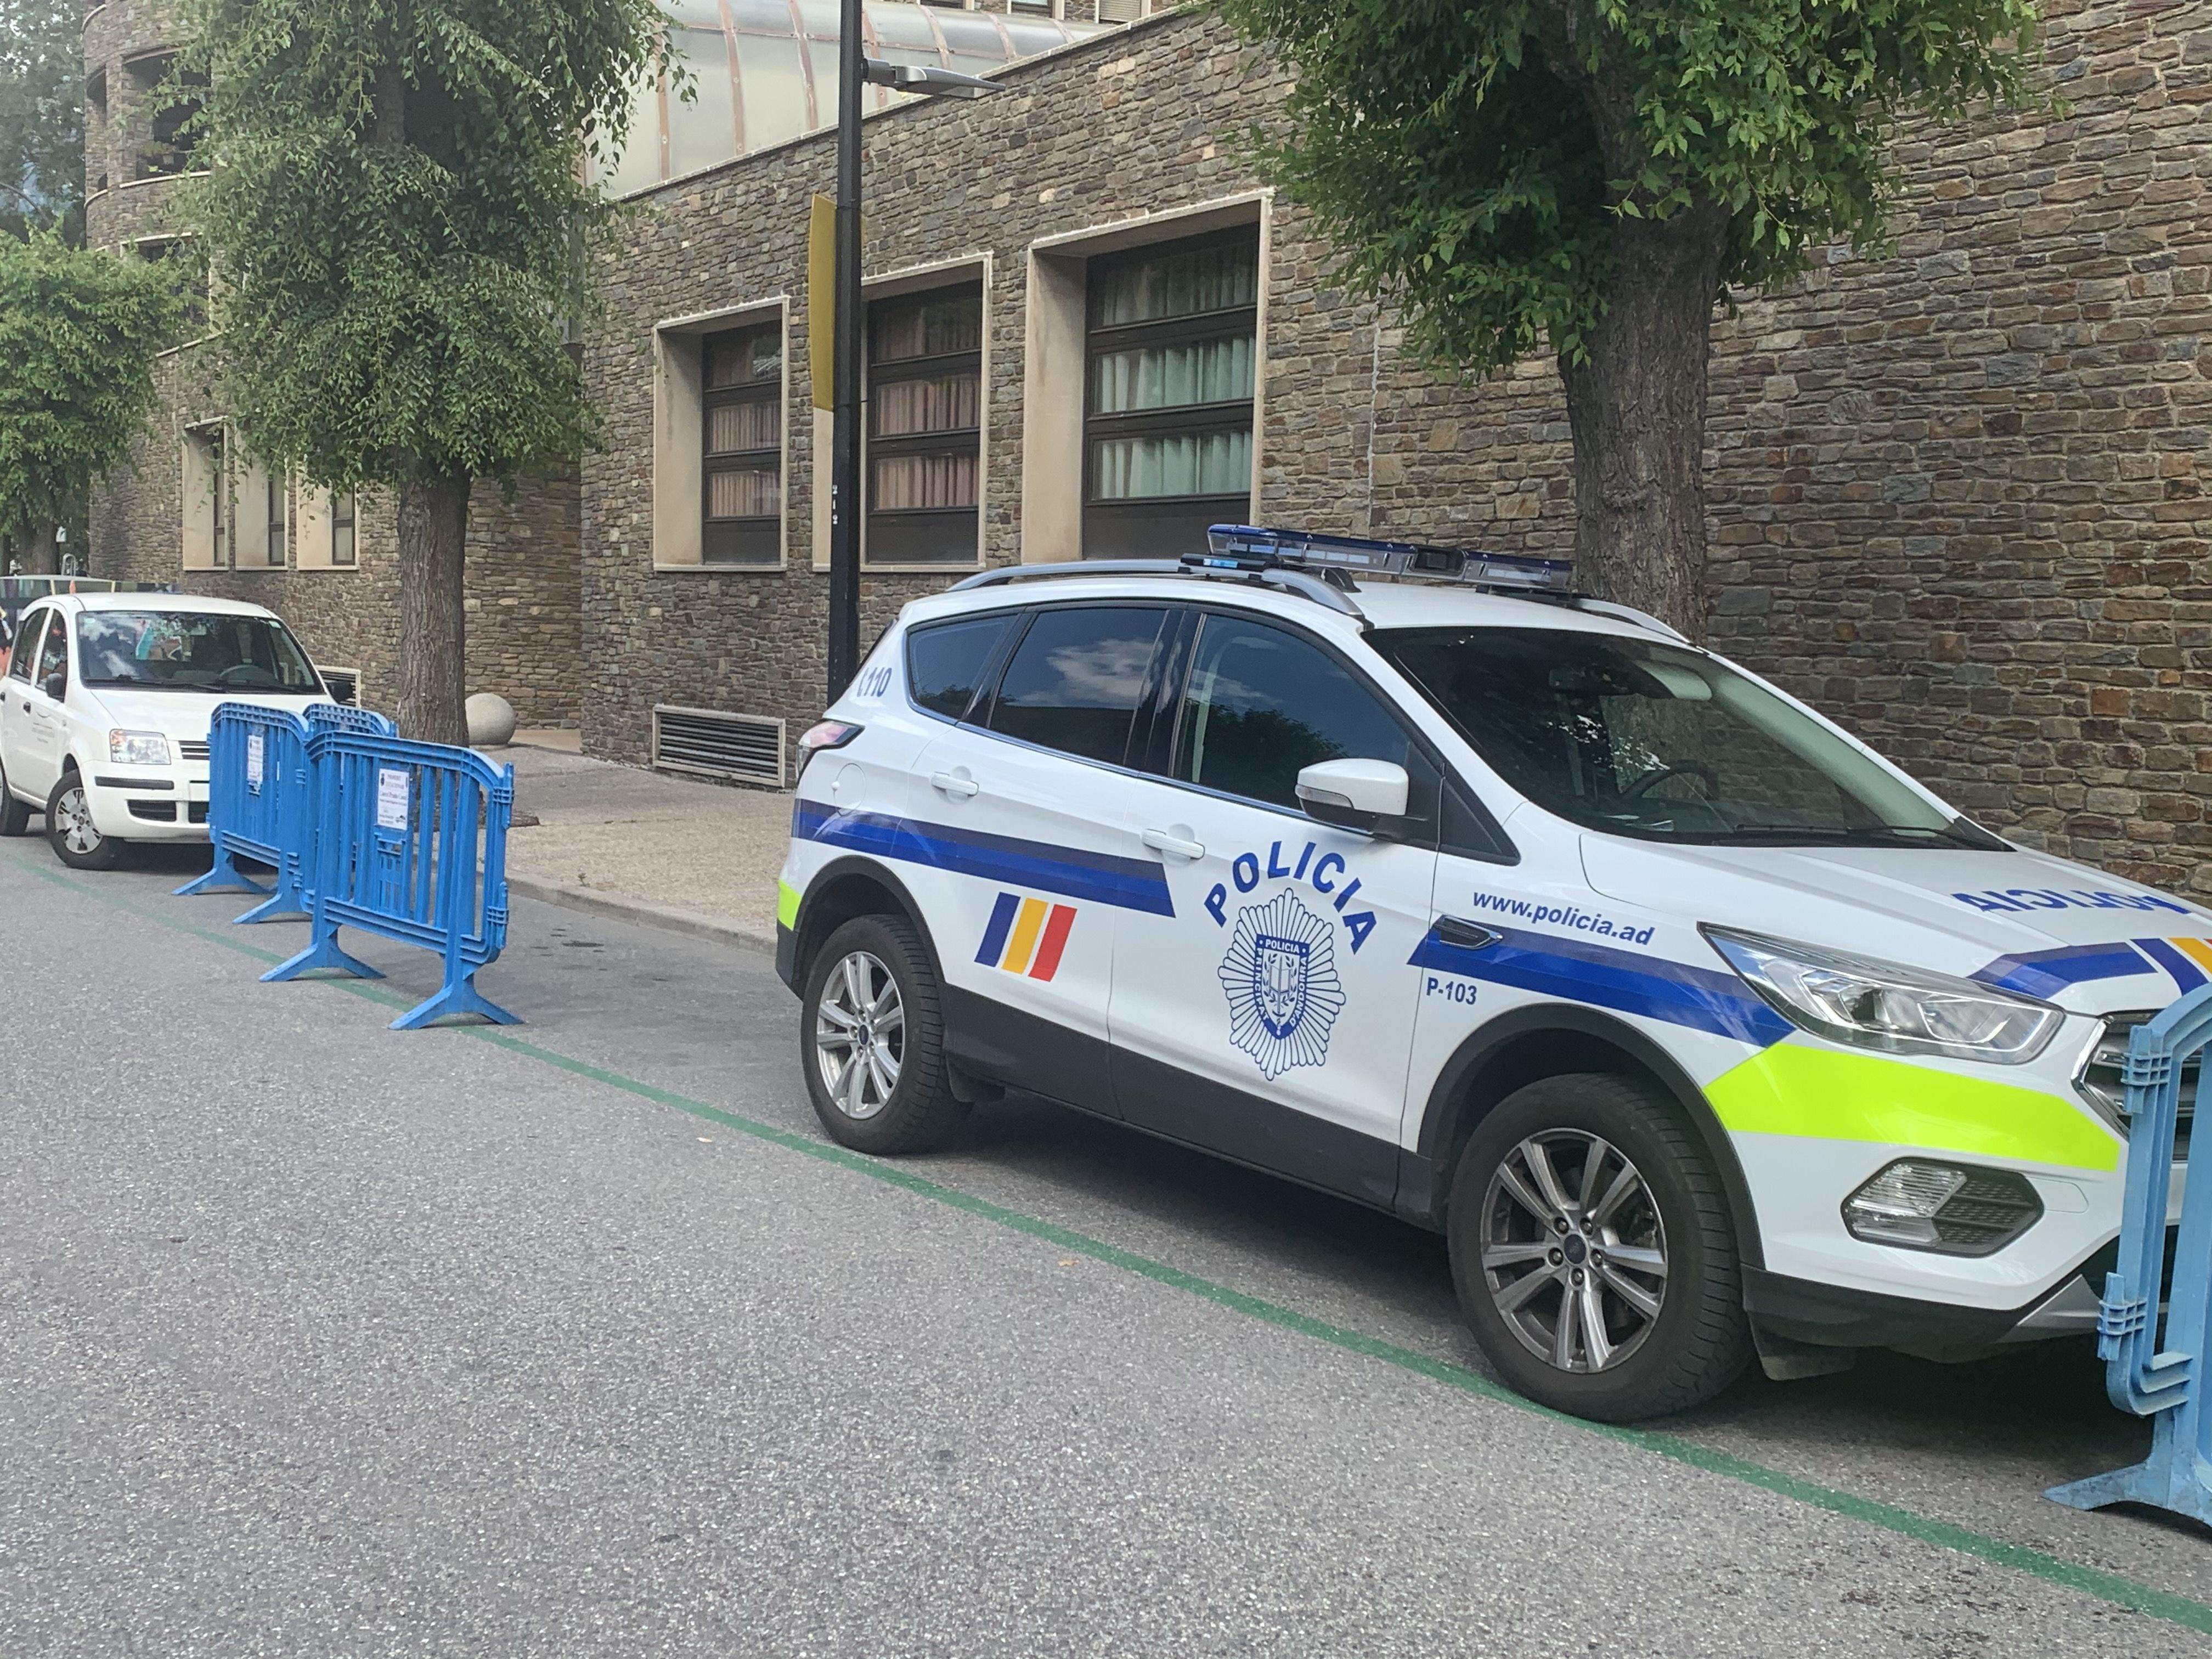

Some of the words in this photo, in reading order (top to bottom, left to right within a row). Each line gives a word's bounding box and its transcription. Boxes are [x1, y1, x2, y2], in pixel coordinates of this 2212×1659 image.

[1204, 840, 1377, 955] POLICIA
[1473, 891, 1655, 945] www.policia.ad
[1265, 939, 1300, 954] POLICIA
[1255, 947, 1269, 1020] PRINCIPAT
[1289, 957, 1307, 1027] D'ANDORRA
[1426, 976, 1477, 1005] P-103
